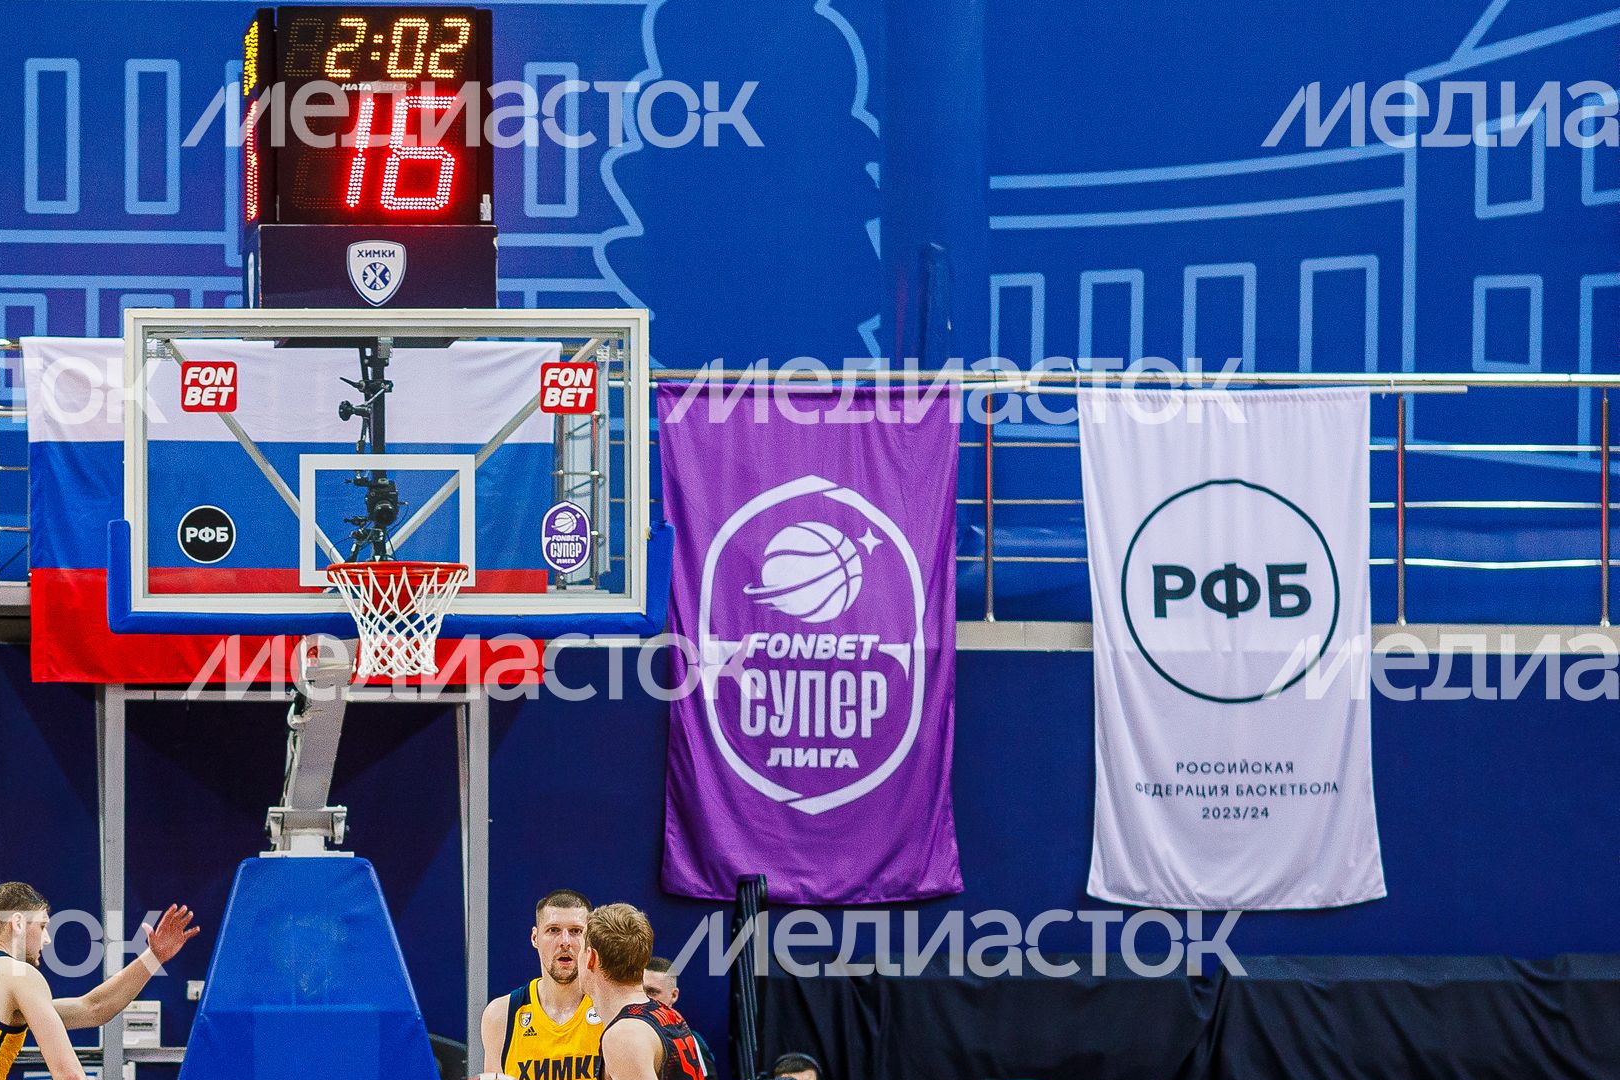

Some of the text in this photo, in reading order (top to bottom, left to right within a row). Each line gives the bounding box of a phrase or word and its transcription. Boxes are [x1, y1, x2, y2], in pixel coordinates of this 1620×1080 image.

[324, 17, 471, 79] 2:02
[346, 95, 457, 211] 16
[357, 250, 395, 258] ХИМКИ
[184, 366, 234, 385] FON
[544, 367, 594, 386] FON
[184, 386, 234, 407] BET
[544, 387, 594, 408] BET
[186, 525, 229, 543] РФБ
[550, 542, 582, 558] СУПЕР
[1152, 563, 1311, 619] РФБ
[746, 632, 879, 660] FONBET
[740, 667, 888, 740] СУПЕР
[766, 747, 859, 769] ЛИГА
[1176, 758, 1294, 775] РОССИЙСКАЯ
[1135, 780, 1339, 798] ФЕДЕРАЦИЯ БАСКЕТБОЛА
[1202, 806, 1269, 820] 2023/24
